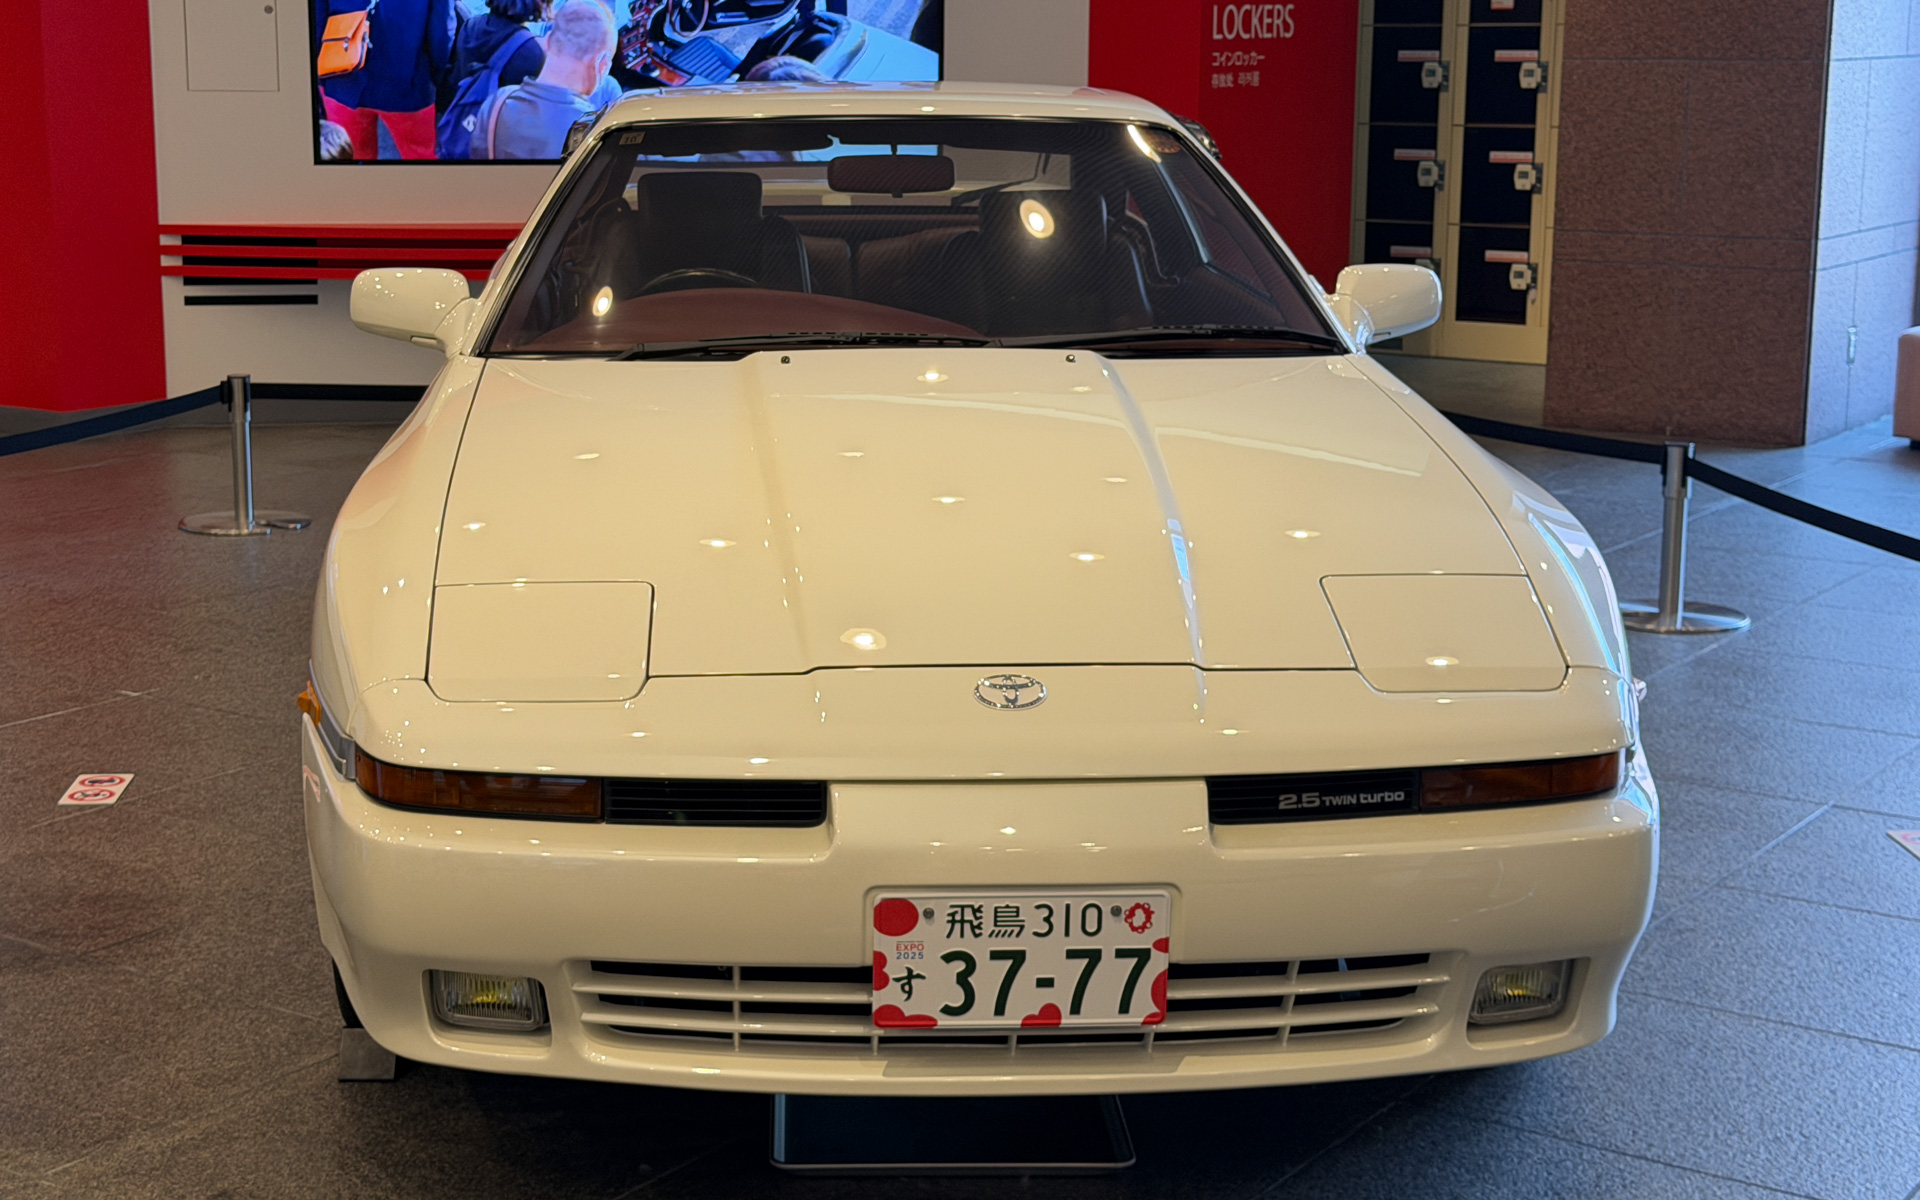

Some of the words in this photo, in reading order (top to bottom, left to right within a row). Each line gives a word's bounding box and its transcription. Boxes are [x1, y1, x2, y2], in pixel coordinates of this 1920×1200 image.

[1212, 4, 1295, 40] LOCKERS
[1211, 51, 1265, 67] コインロッカー
[1278, 792, 1320, 810] 2.5
[1322, 794, 1357, 807] TWIN
[1359, 791, 1405, 804] turbo
[896, 943, 925, 951] EXPO
[896, 951, 924, 960] 2025
[892, 966, 926, 1002] す
[939, 948, 1152, 1017] 37-77
